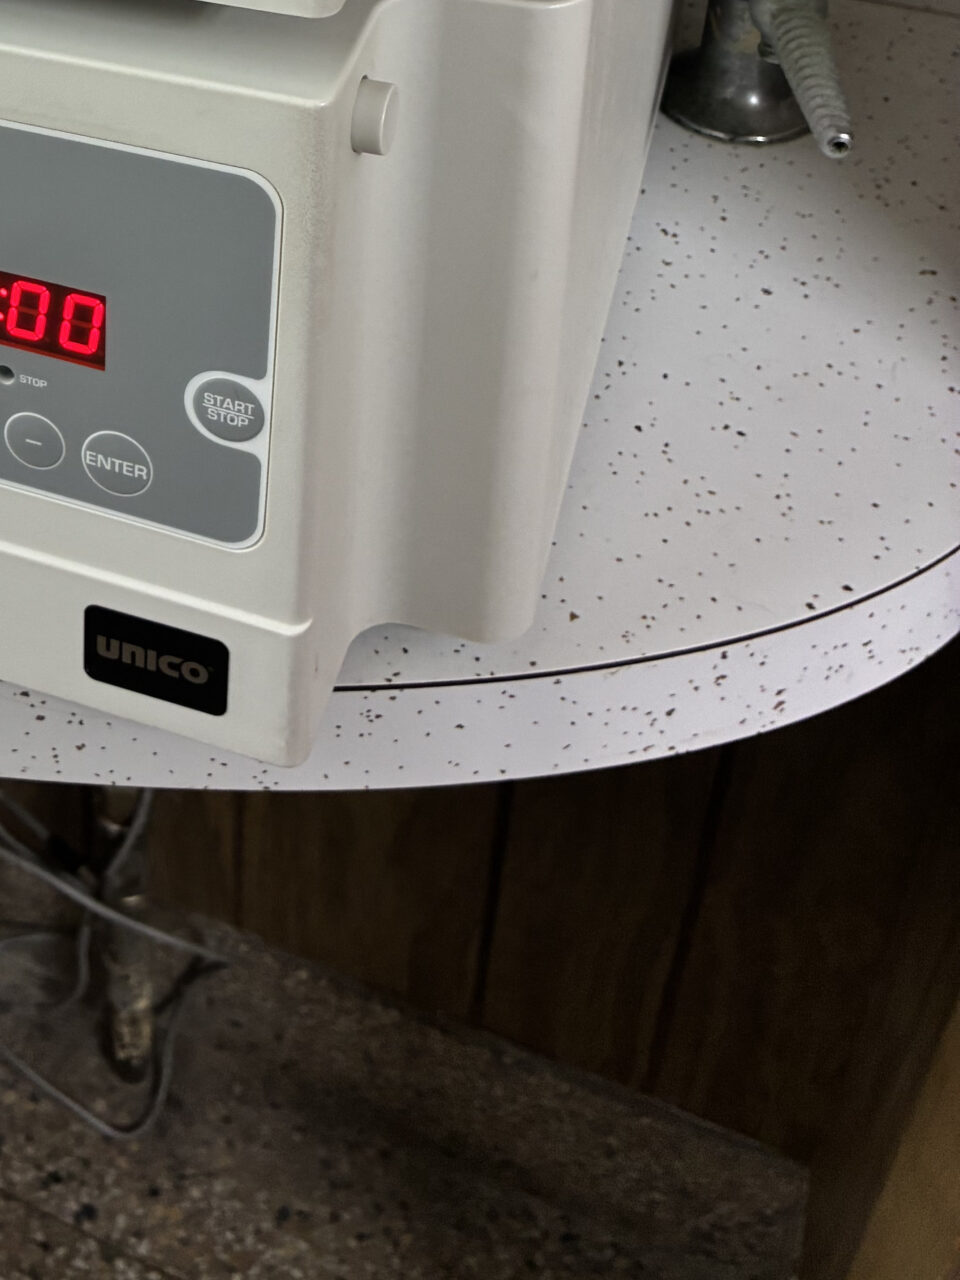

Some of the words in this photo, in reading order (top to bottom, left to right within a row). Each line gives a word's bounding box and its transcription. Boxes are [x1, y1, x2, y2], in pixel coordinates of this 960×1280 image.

[19, 373, 48, 388] STOP
[203, 392, 255, 415] START
[207, 407, 249, 427] STOP
[85, 450, 148, 480] ENTER
